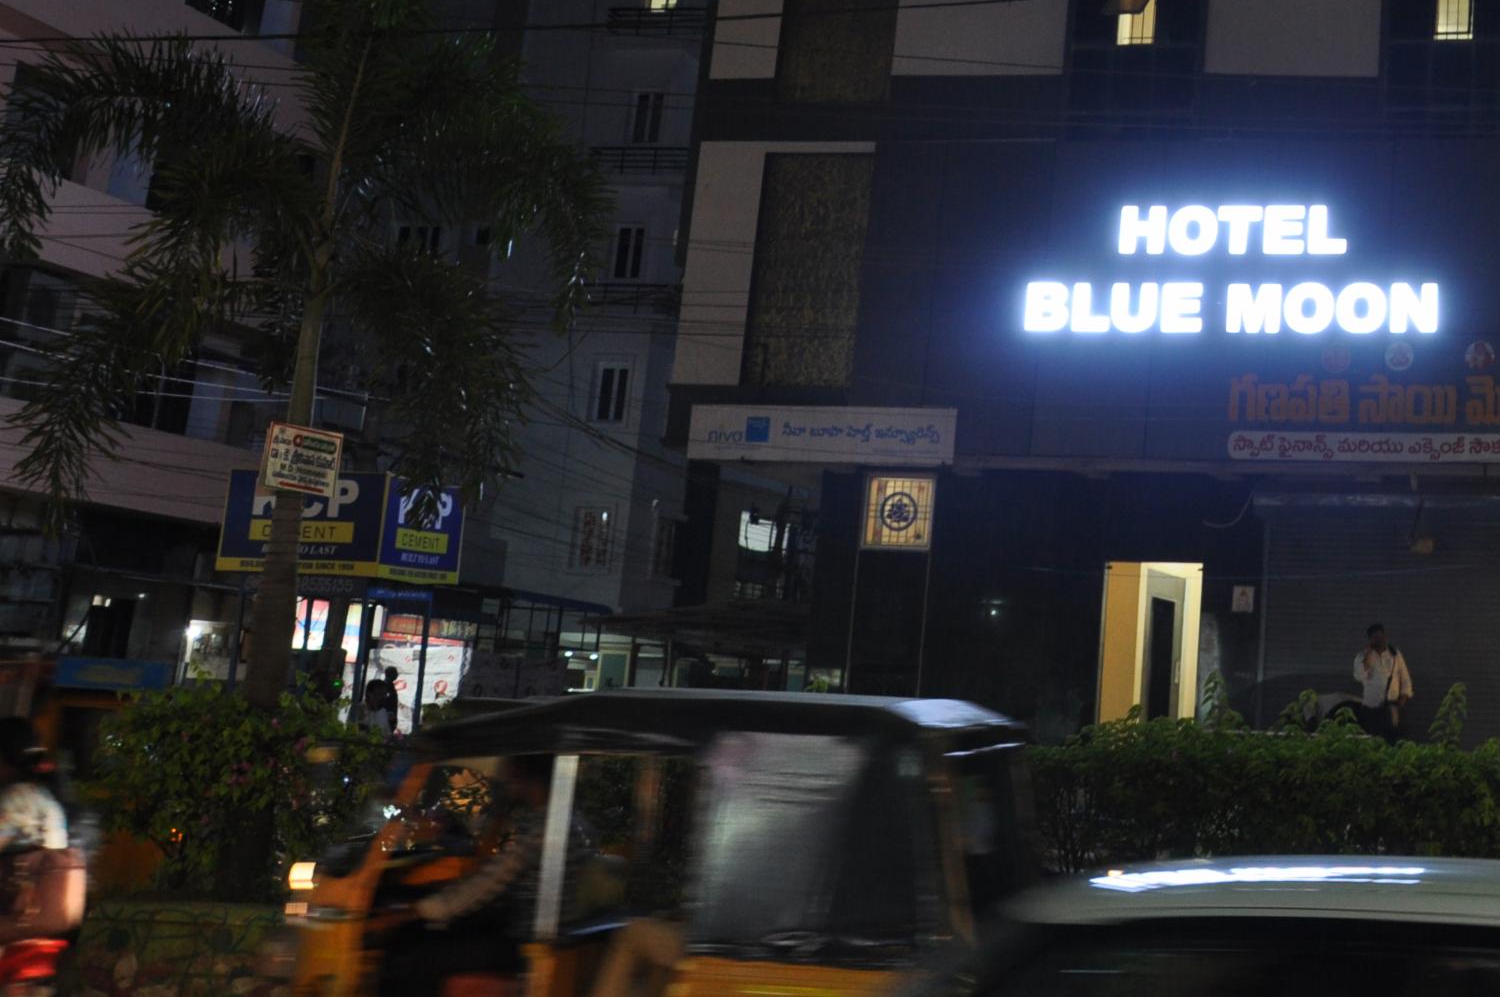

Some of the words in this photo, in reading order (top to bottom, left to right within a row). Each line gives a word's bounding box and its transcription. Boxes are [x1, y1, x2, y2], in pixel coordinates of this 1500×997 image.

[1118, 205, 1348, 255] HOTEL
[1023, 281, 1204, 333] BLUE
[1225, 282, 1440, 334] MOON
[262, 524, 337, 540] CENT
[398, 488, 453, 530] KP
